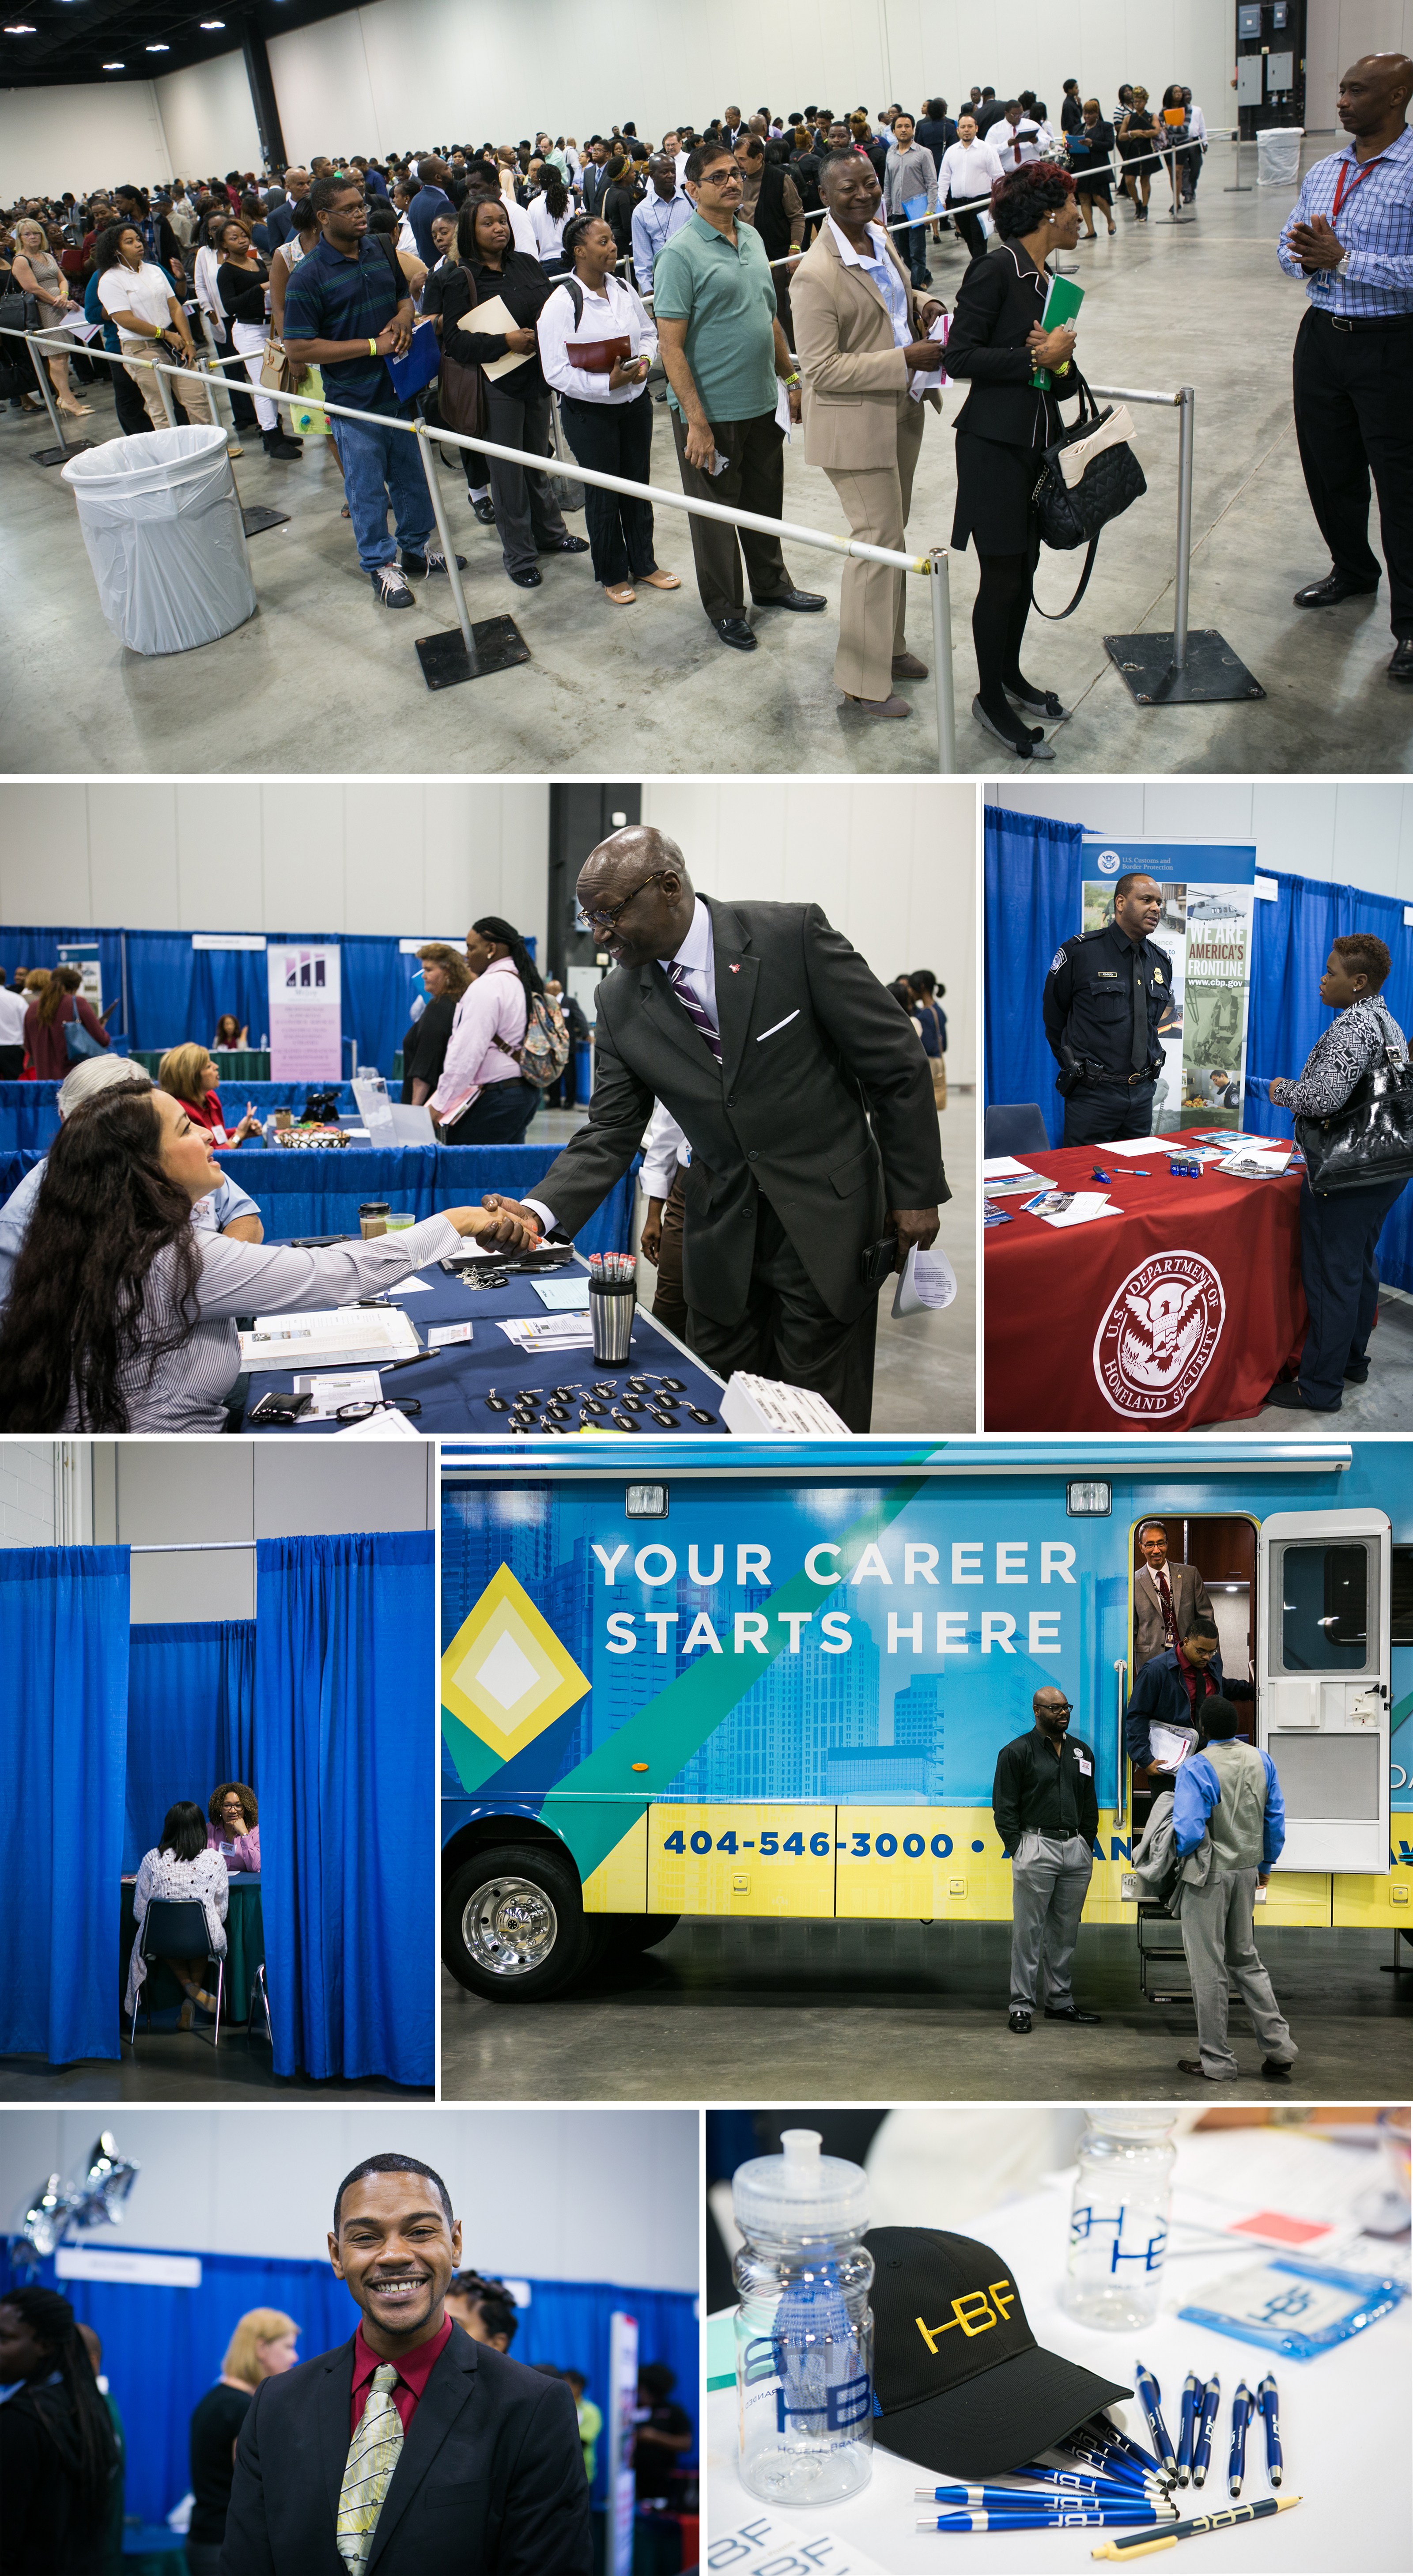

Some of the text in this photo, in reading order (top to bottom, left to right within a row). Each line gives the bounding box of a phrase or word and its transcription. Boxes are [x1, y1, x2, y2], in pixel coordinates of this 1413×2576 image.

[1190, 921, 1244, 944] WE ARE
[1189, 944, 1244, 960] AMERICA'S
[1188, 960, 1243, 977] FRONTLINE
[1188, 979, 1243, 988] www.cbp.gov
[1106, 1259, 1219, 1338] U.S. DEPARTMENT OF
[1104, 1325, 1217, 1410] HOMELAND SECURITY
[592, 1542, 1077, 1586] YOUR CAREER
[1157, 1591, 1169, 1608] ORACLE
[605, 1611, 1061, 1654] STARTS HERE
[664, 1830, 953, 1858] 404-546-3000
[915, 2279, 1015, 2354] HBF
